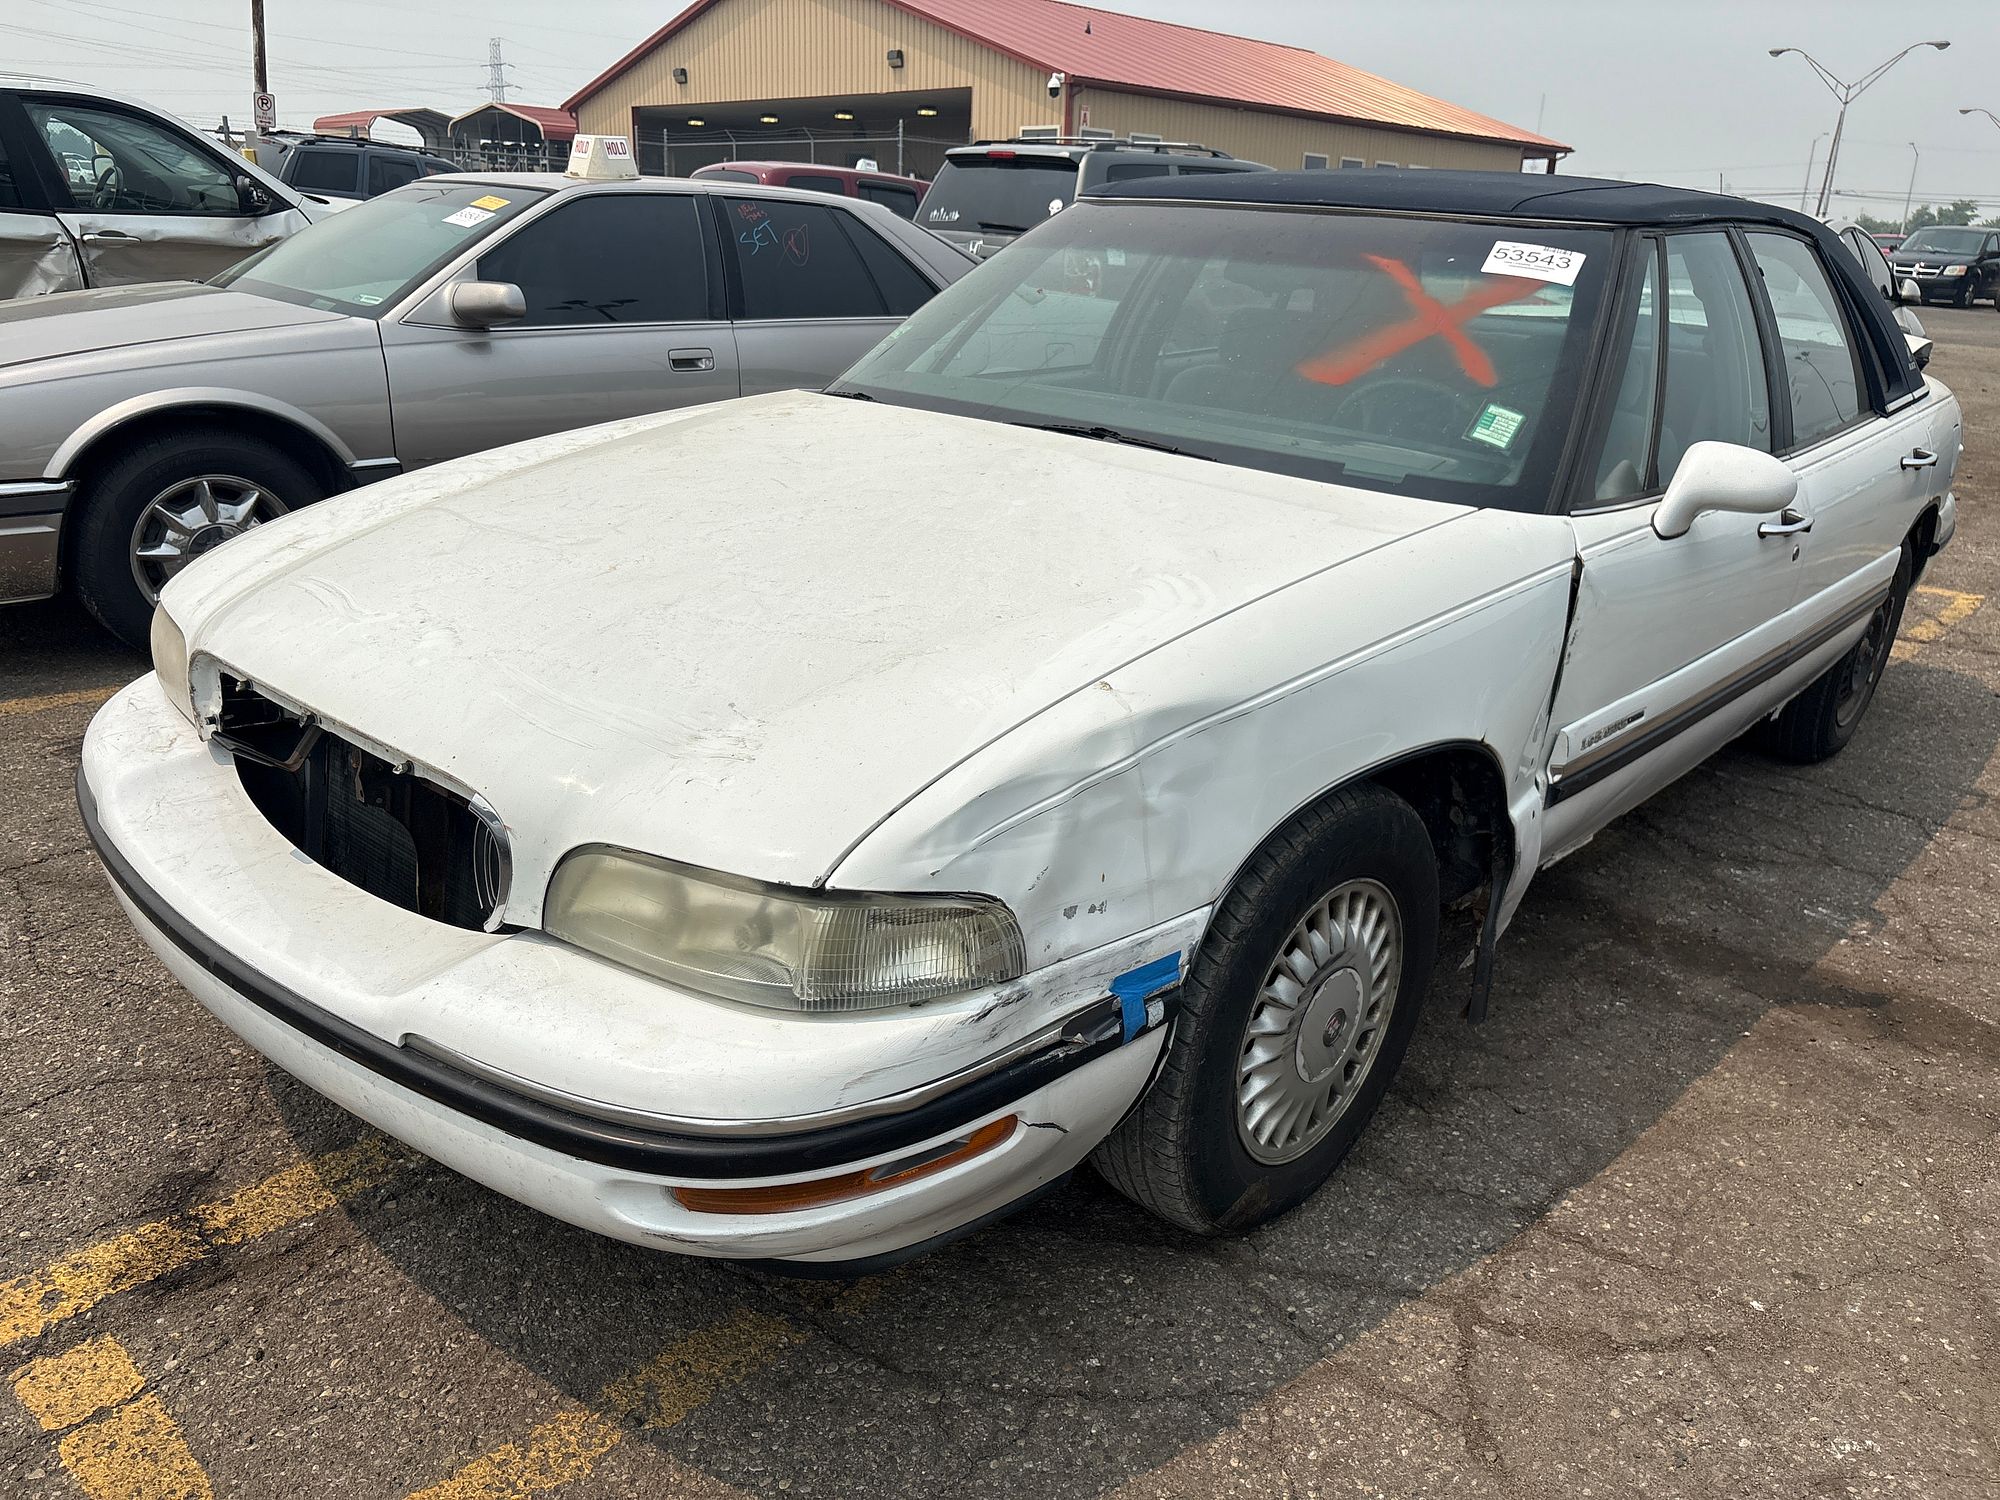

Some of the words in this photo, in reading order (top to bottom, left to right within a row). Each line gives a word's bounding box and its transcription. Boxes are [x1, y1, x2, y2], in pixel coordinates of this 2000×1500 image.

[575, 139, 590, 154] HOLD
[605, 141, 627, 156] HOLD
[739, 220, 778, 255] SET
[1493, 247, 1571, 270] 53543
